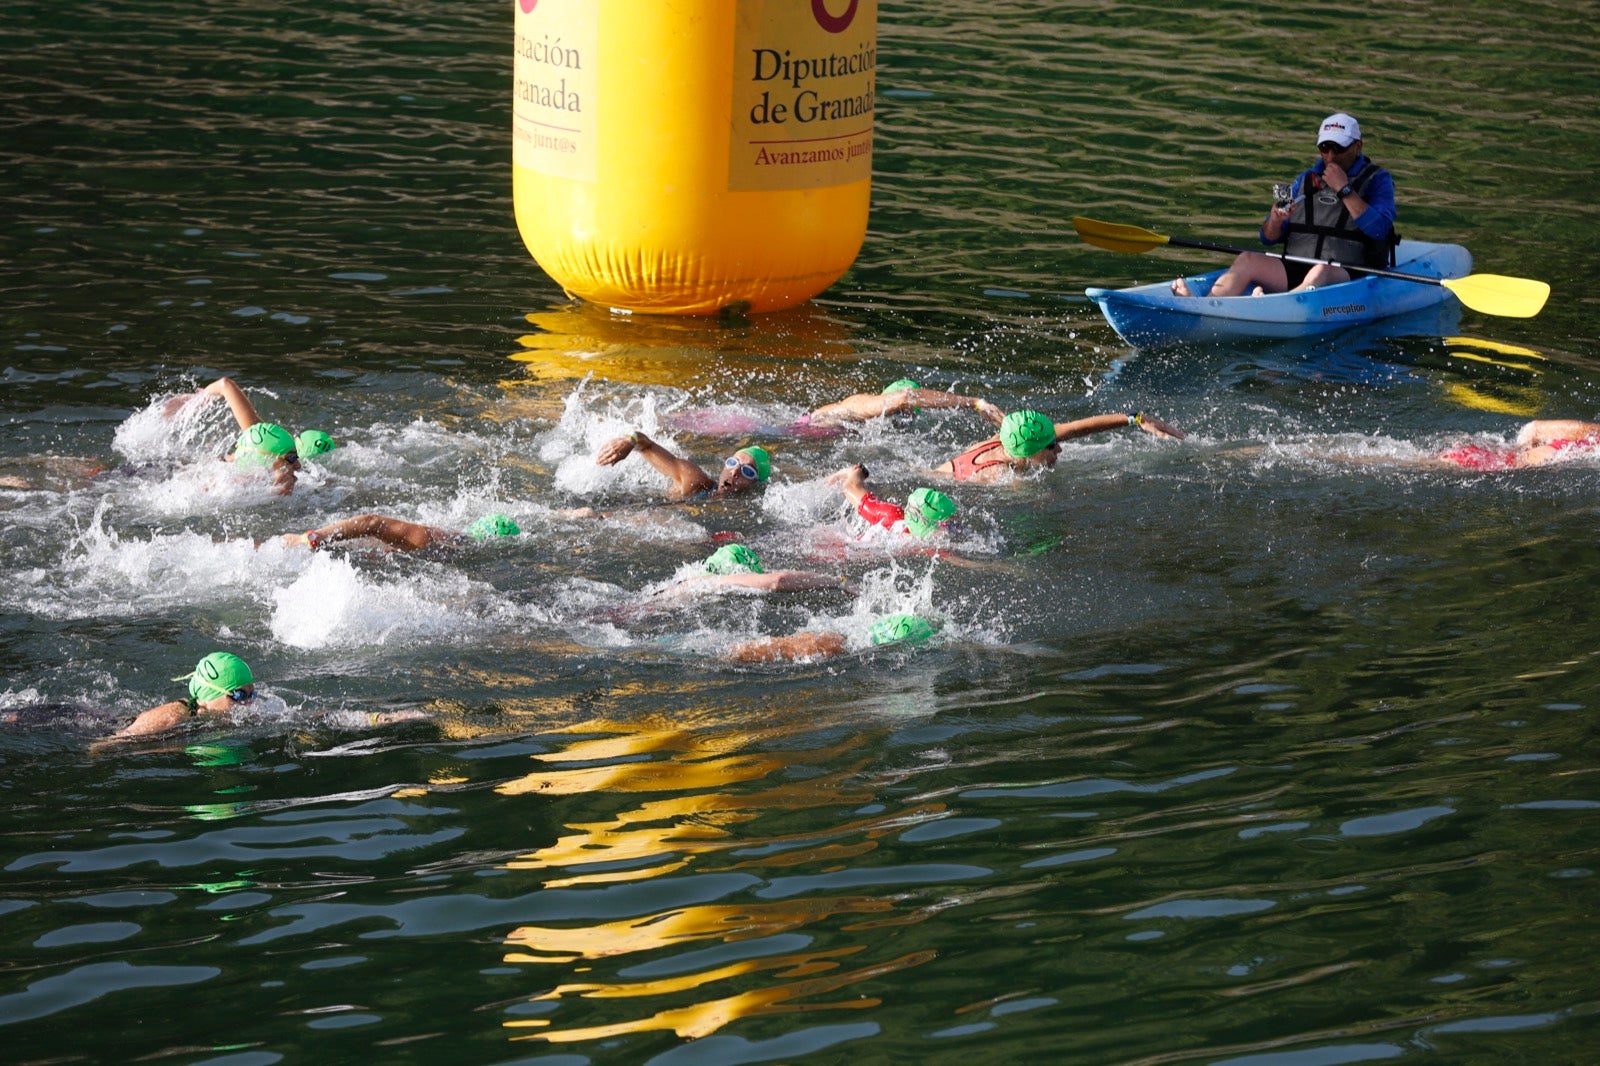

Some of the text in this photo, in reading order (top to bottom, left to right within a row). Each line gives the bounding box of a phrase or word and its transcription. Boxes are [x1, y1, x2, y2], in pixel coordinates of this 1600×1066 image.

[751, 42, 875, 88] Diputación
[750, 92, 787, 125] de
[754, 147, 845, 166] Avanzamos
[1322, 302, 1366, 317] perception
